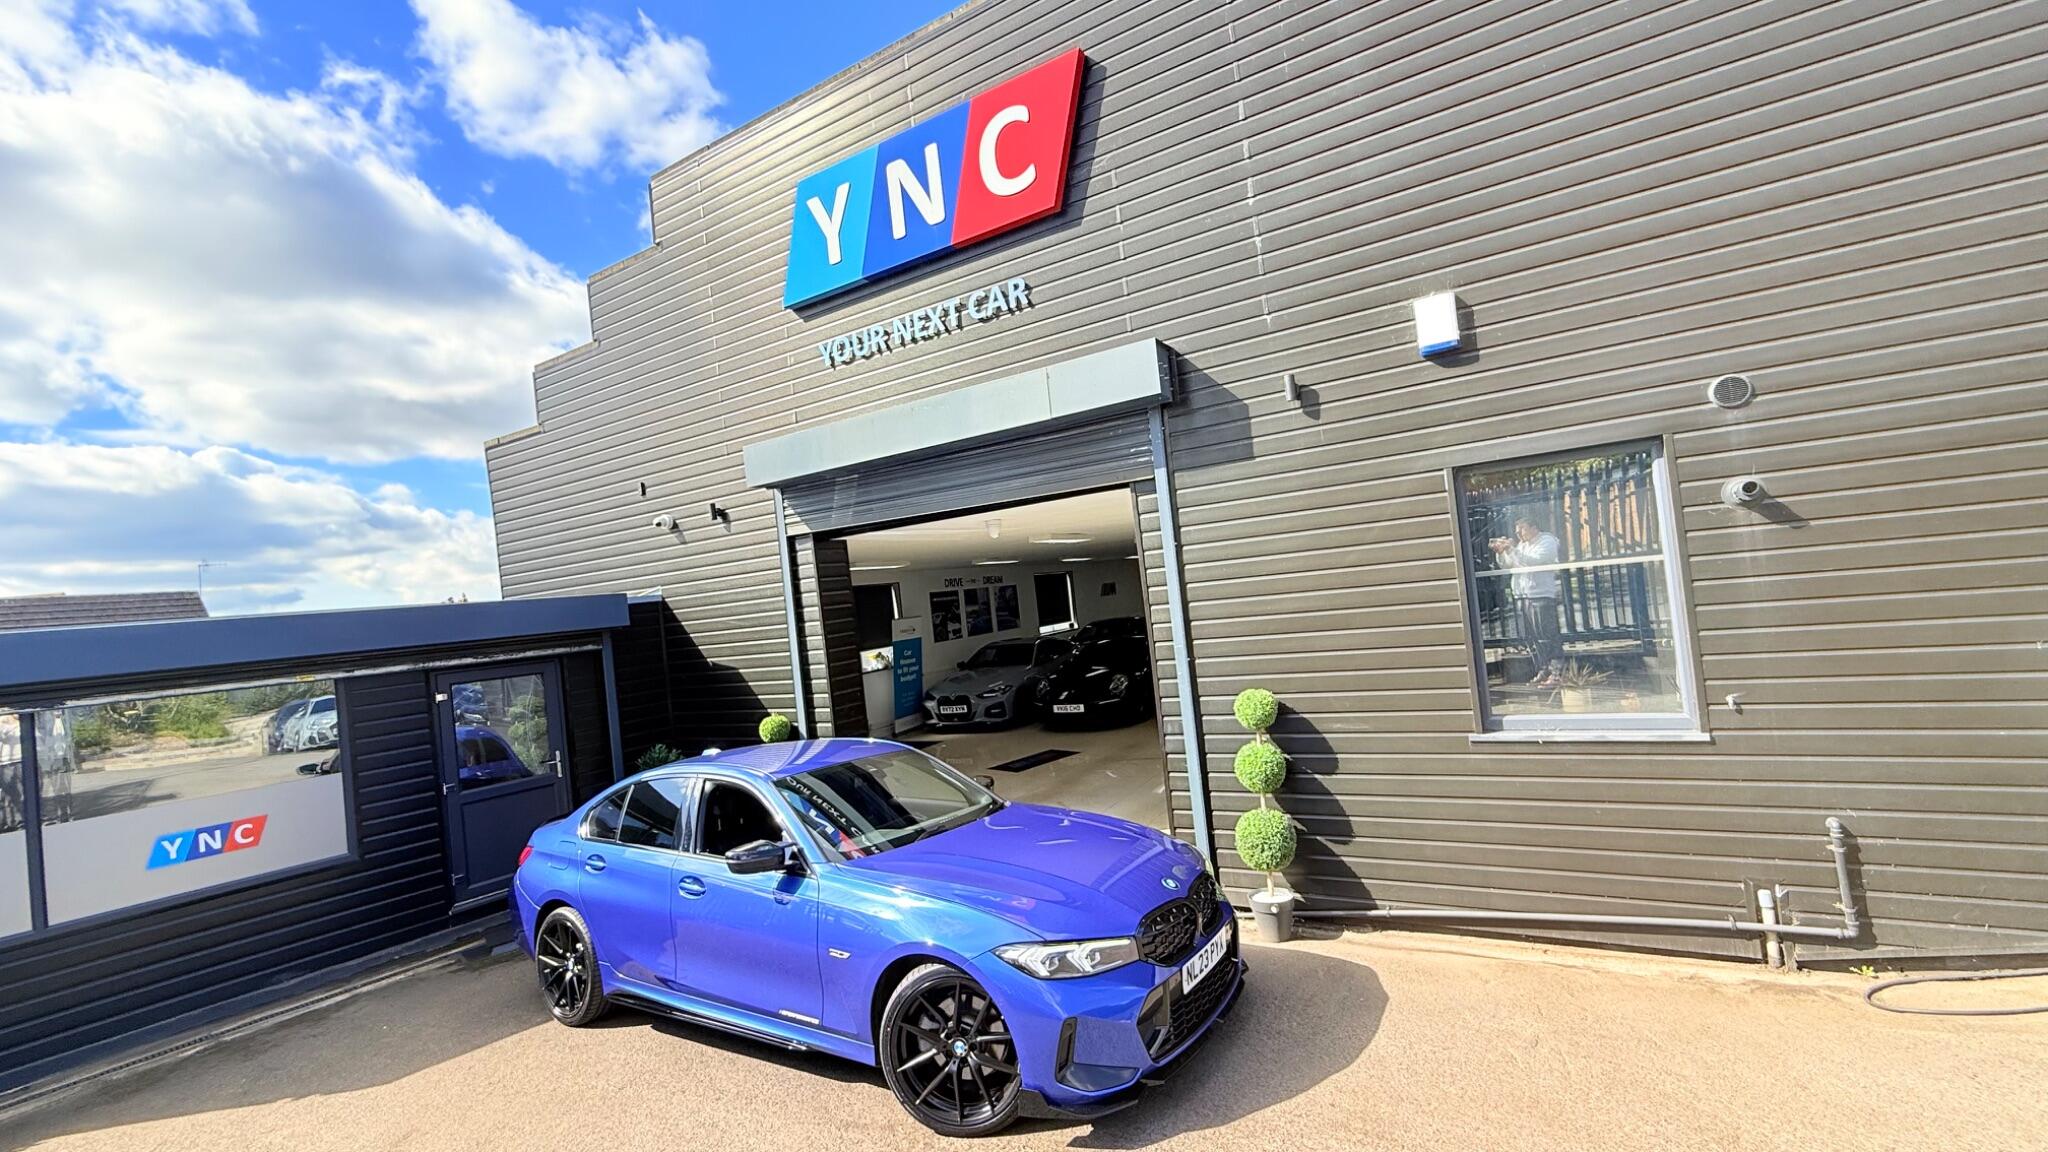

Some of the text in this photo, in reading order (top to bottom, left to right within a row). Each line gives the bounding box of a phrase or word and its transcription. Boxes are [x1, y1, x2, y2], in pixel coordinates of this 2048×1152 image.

[806, 104, 1037, 265] YNC
[818, 276, 1029, 367] YOUR NEXT CAR
[944, 578, 964, 587] DRIVE
[161, 823, 255, 860] YNC
[1186, 934, 1224, 985] NL23 PYX
